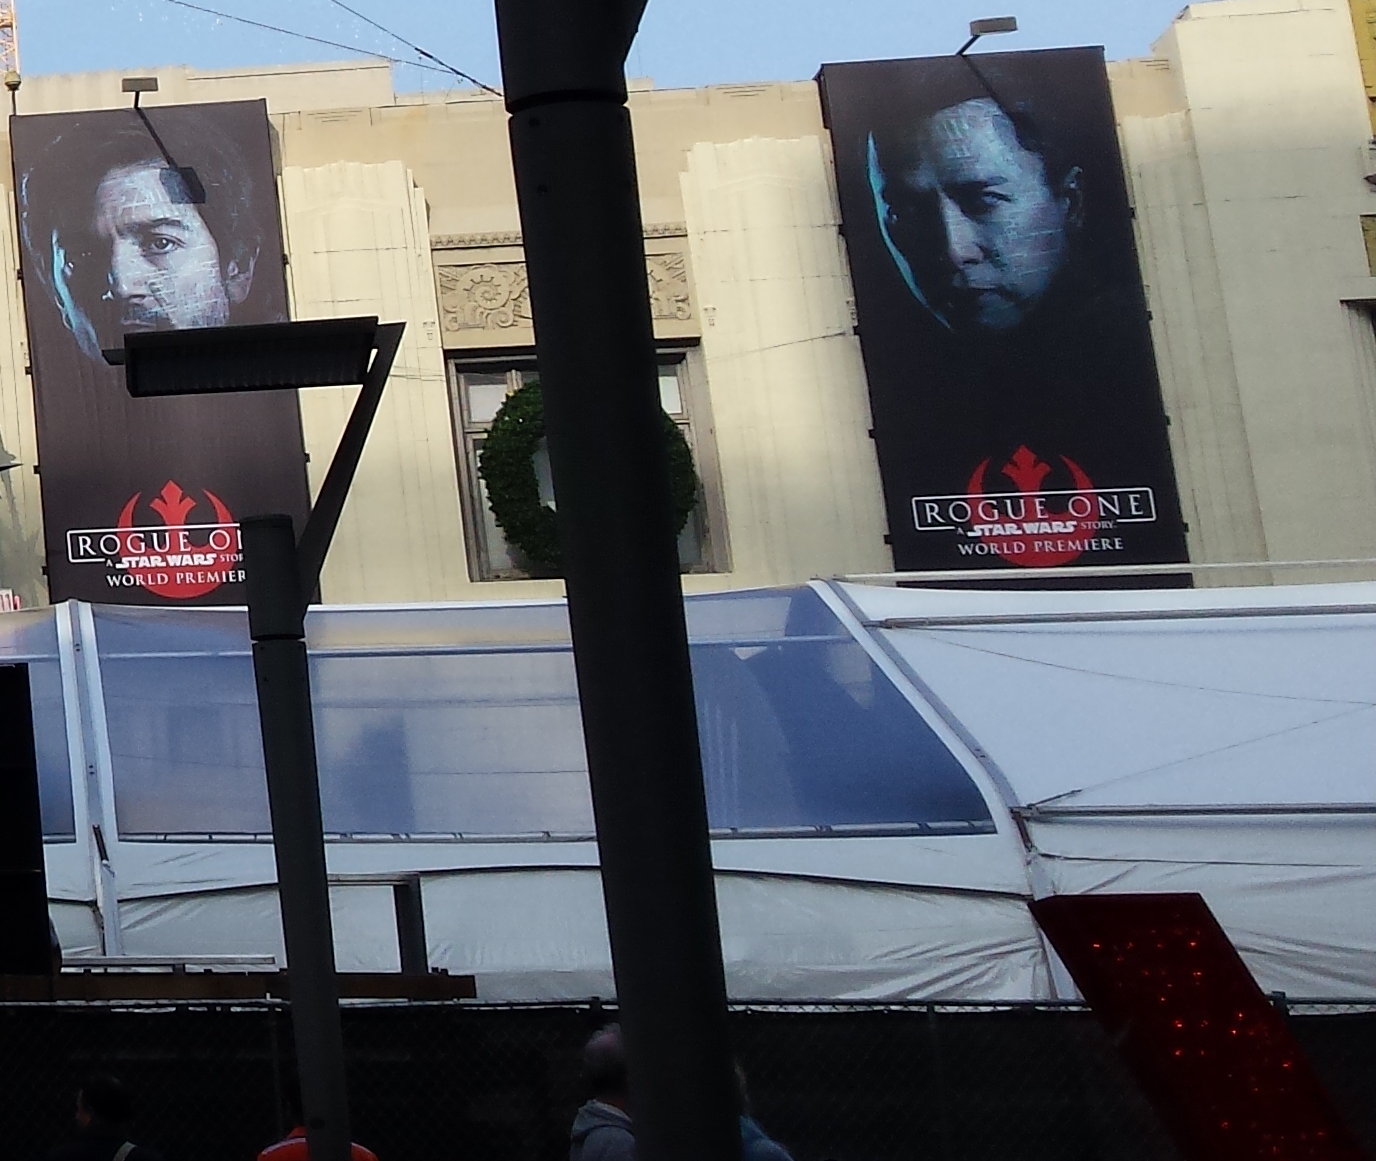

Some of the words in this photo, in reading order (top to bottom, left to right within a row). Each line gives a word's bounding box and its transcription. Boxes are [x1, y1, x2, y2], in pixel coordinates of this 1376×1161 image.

[924, 498, 1049, 525] ROGUE
[1067, 493, 1145, 518] ONE
[967, 523, 1023, 537] STAR
[1022, 520, 1078, 534] WARS
[1080, 521, 1115, 530] STORY
[78, 531, 192, 557] ROGUE
[957, 541, 1026, 556] WORLD
[1033, 537, 1124, 553] PREMIERE
[115, 555, 167, 569] STAR
[167, 552, 218, 568] WARS
[106, 572, 169, 587] WORLD
